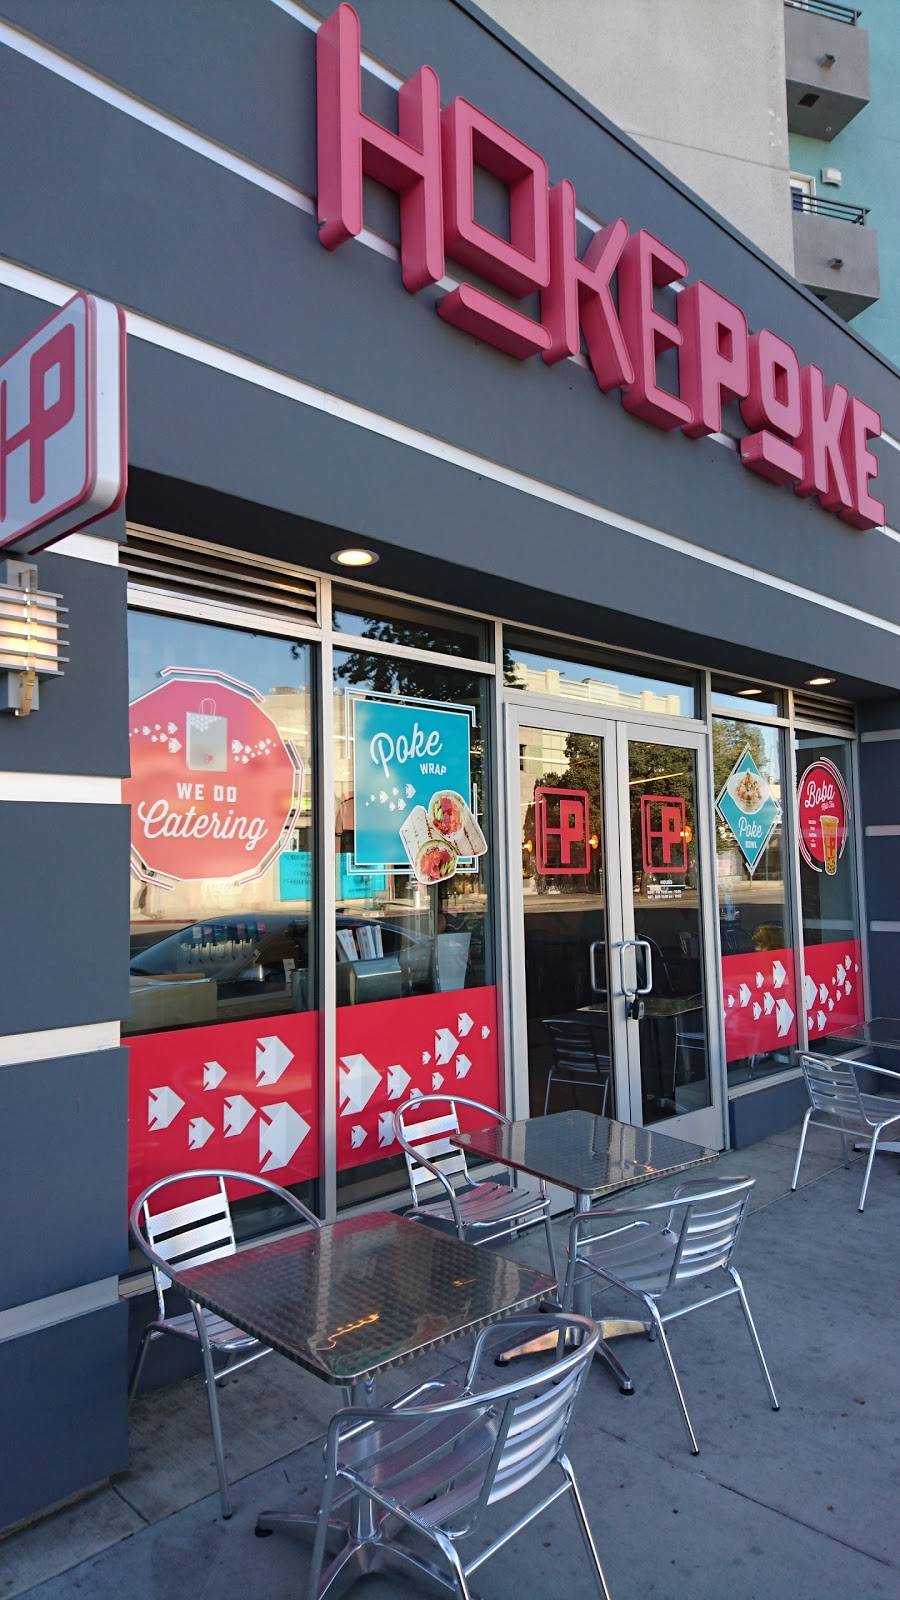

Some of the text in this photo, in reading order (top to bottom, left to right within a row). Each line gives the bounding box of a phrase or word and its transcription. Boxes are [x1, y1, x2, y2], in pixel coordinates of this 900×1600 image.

[369, 722, 443, 778] Poke
[420, 762, 447, 776] WRAP
[176, 782, 237, 802] WE DO
[804, 780, 836, 808] Boba
[137, 799, 269, 851] Catering
[738, 816, 763, 838] Poke
